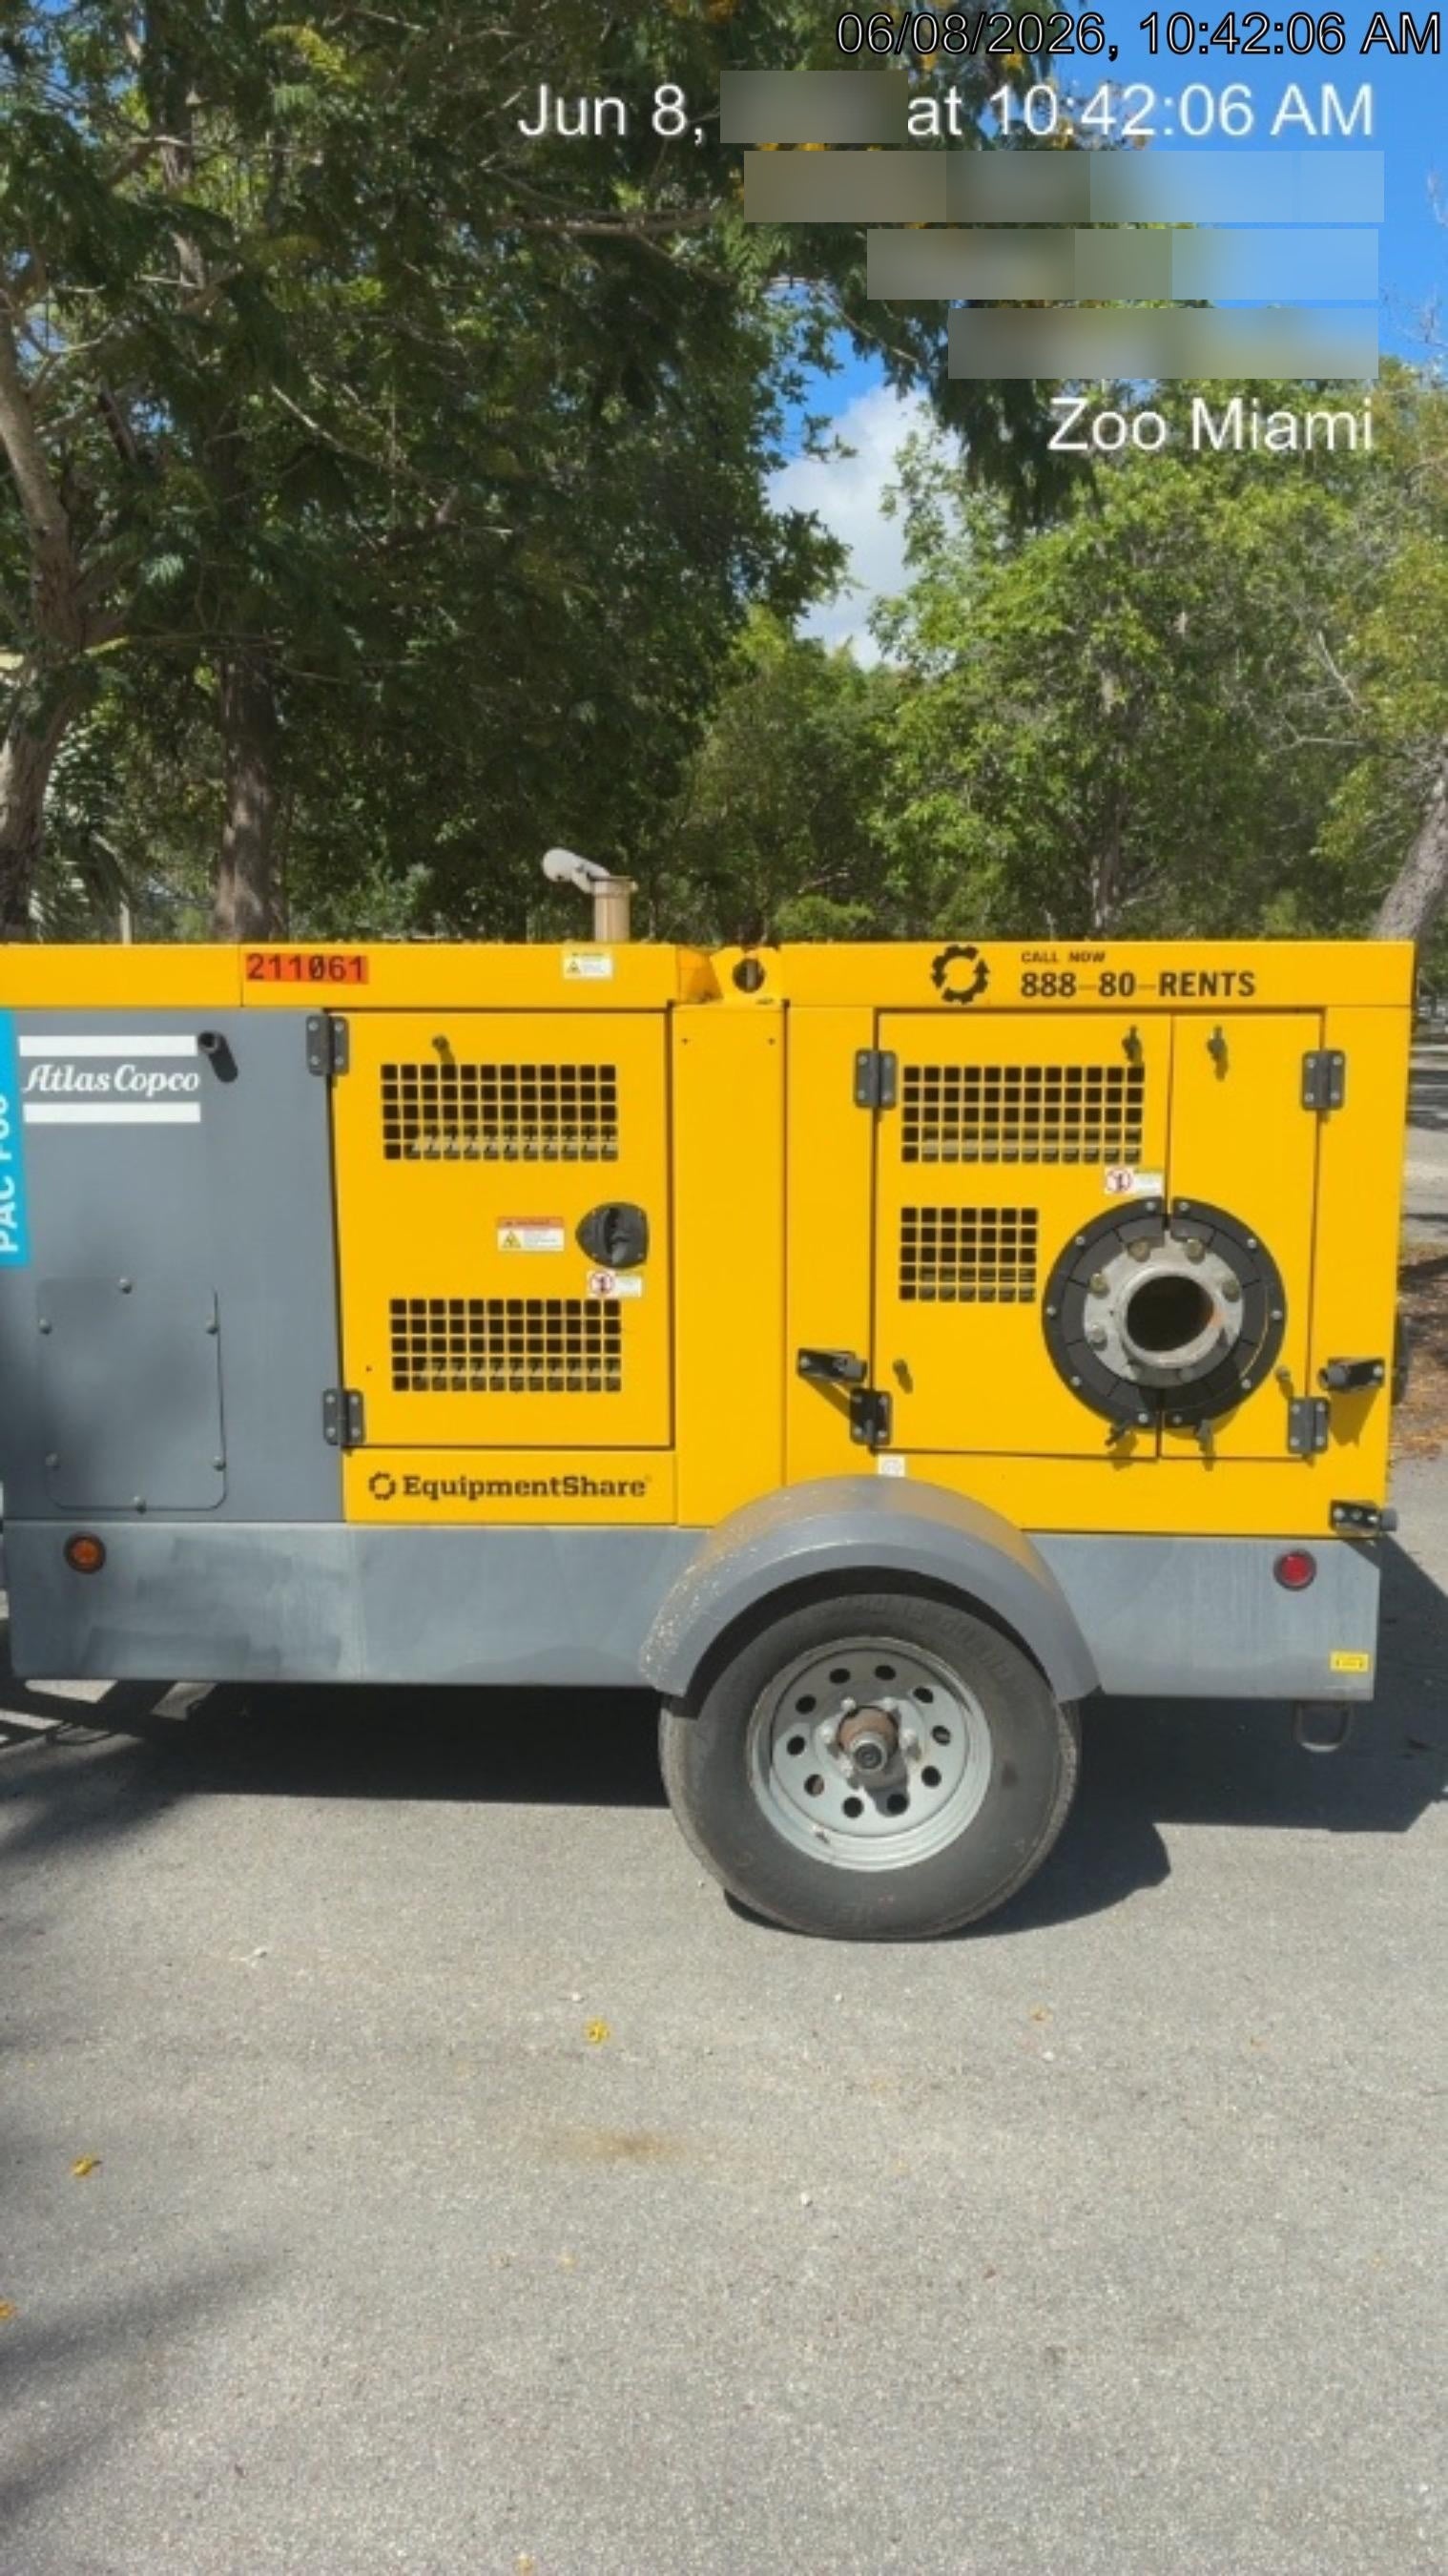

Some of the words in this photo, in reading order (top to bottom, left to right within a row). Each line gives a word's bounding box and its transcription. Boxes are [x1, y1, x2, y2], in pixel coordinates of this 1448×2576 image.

[246, 953, 366, 982] 211061
[1021, 950, 1059, 964] CALL
[1069, 950, 1106, 964] NOW
[1021, 971, 1255, 997] 888-80-RENTS
[403, 1475, 644, 1501] EquipmentShare
